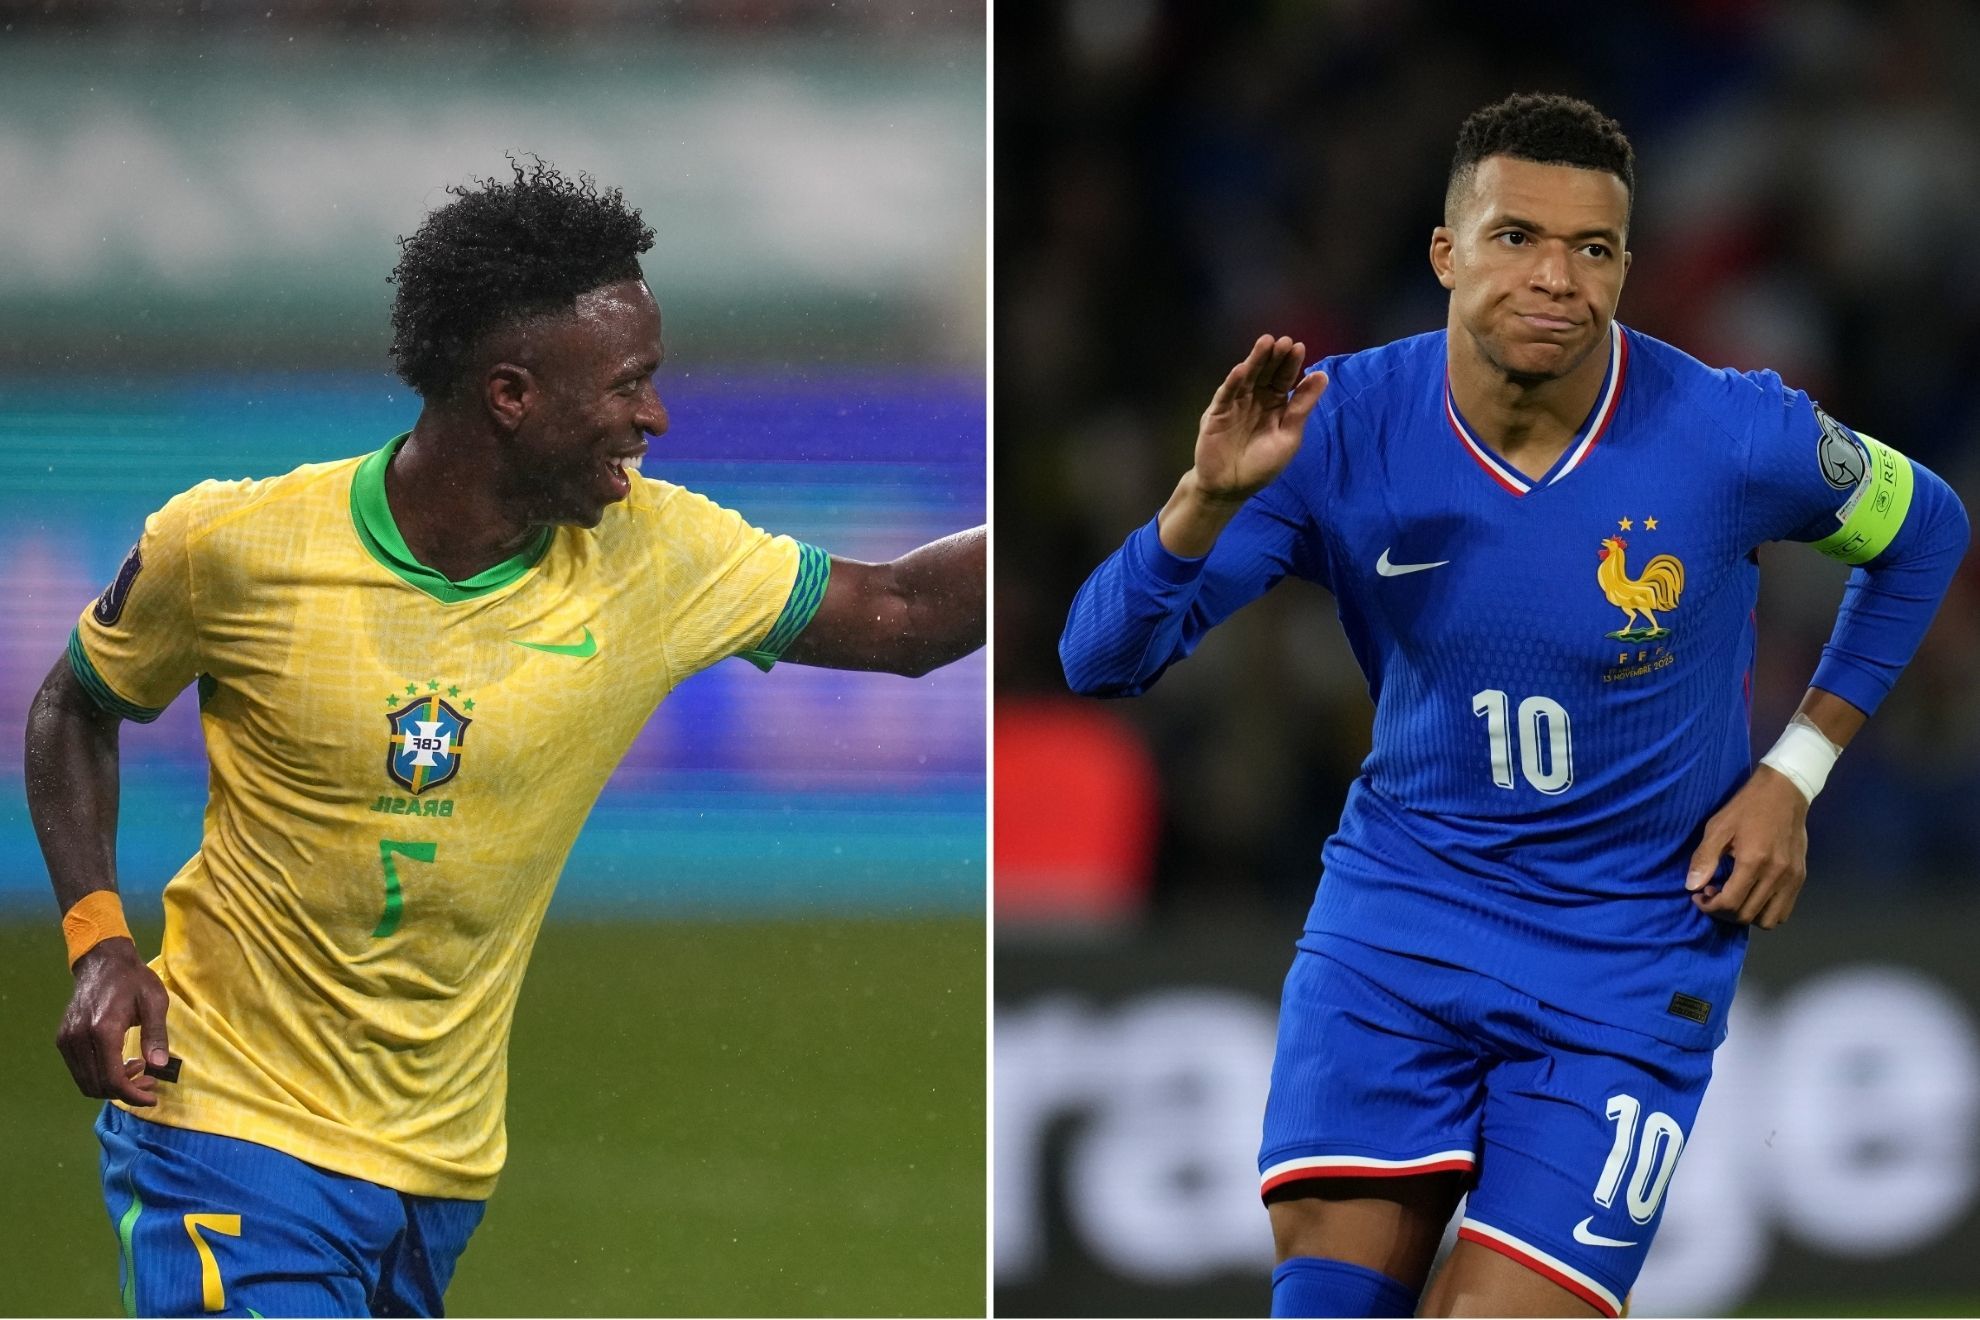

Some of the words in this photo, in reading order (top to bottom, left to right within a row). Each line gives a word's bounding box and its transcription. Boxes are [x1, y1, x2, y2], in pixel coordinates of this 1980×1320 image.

[1613, 664, 1652, 681] NOVEMBRE
[1654, 654, 1674, 671] 2025
[1472, 688, 1574, 795] 10
[1592, 1093, 1684, 1225] 10
